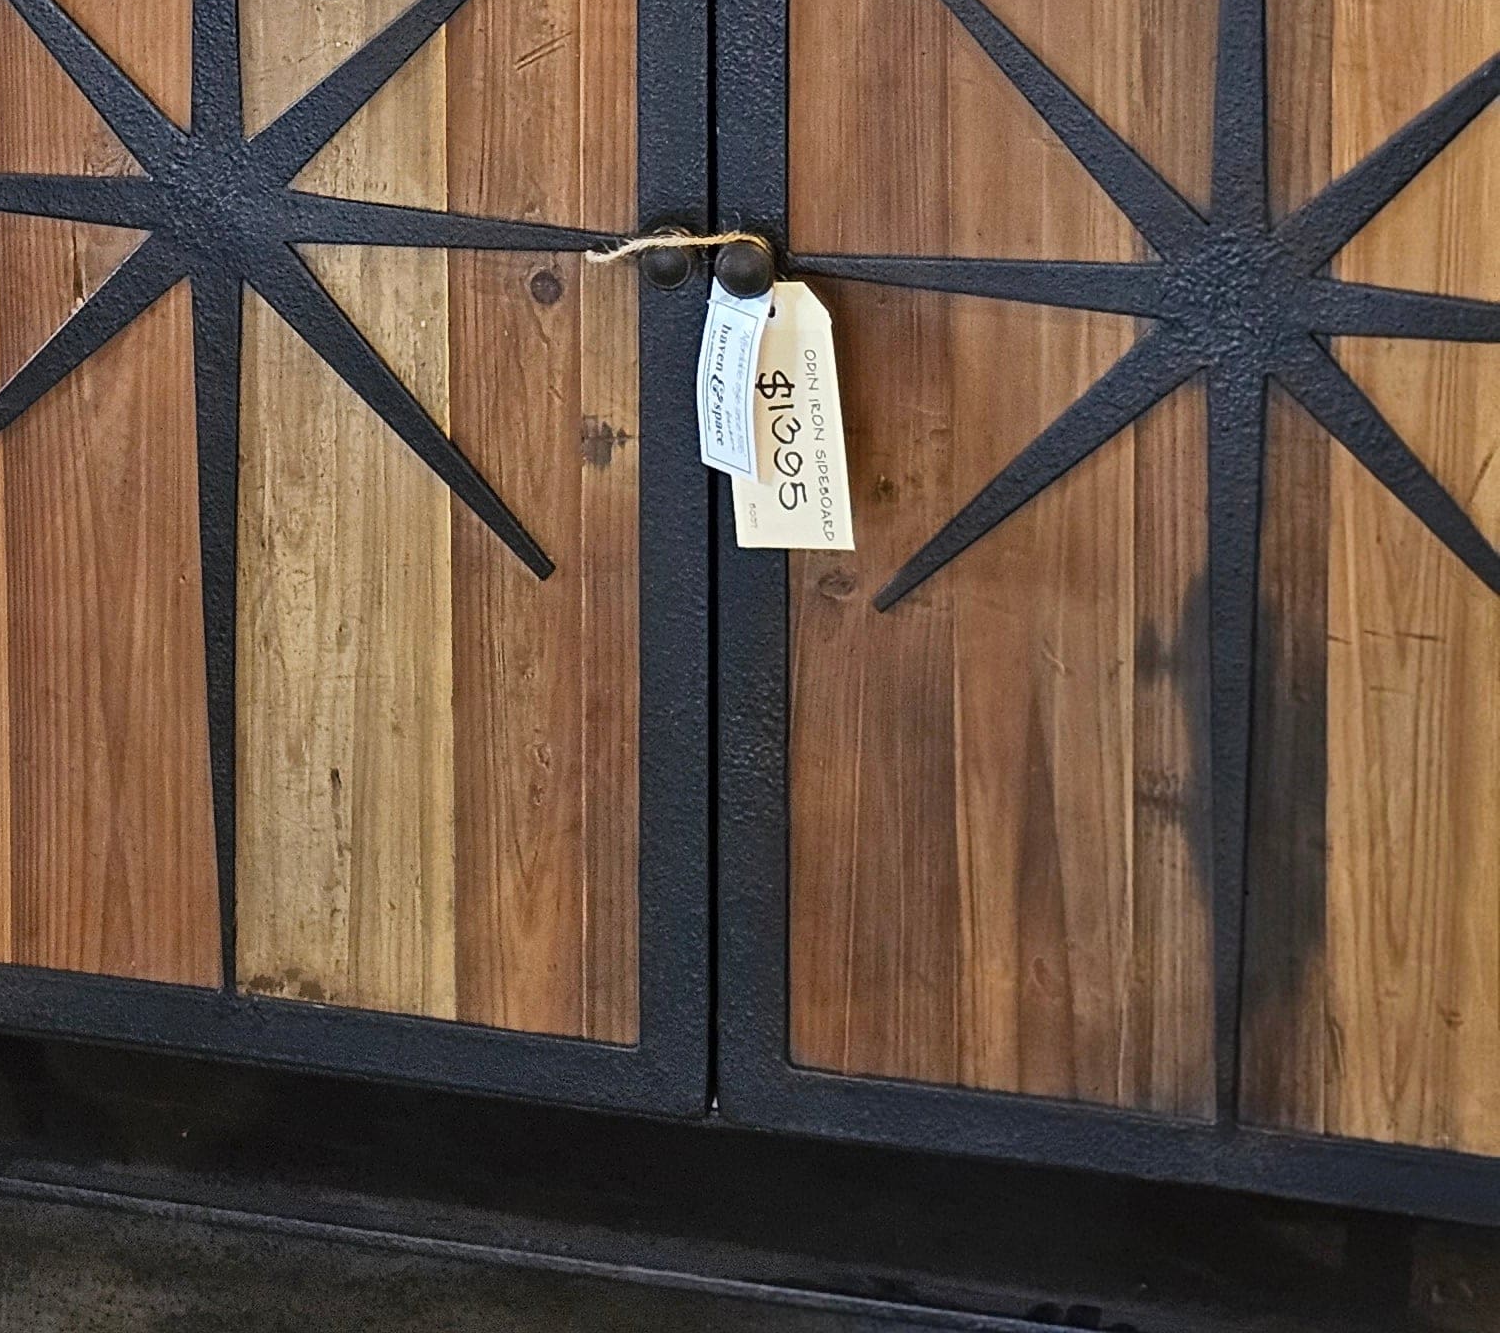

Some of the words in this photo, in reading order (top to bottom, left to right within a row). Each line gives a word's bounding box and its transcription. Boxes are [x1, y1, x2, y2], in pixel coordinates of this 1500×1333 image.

[714, 323, 732, 372] haven
[803, 349, 819, 391] ODIN
[711, 402, 726, 447] space
[754, 369, 808, 511] $1395
[808, 398, 825, 442] IRON
[814, 448, 835, 542] SIDEBOARD
